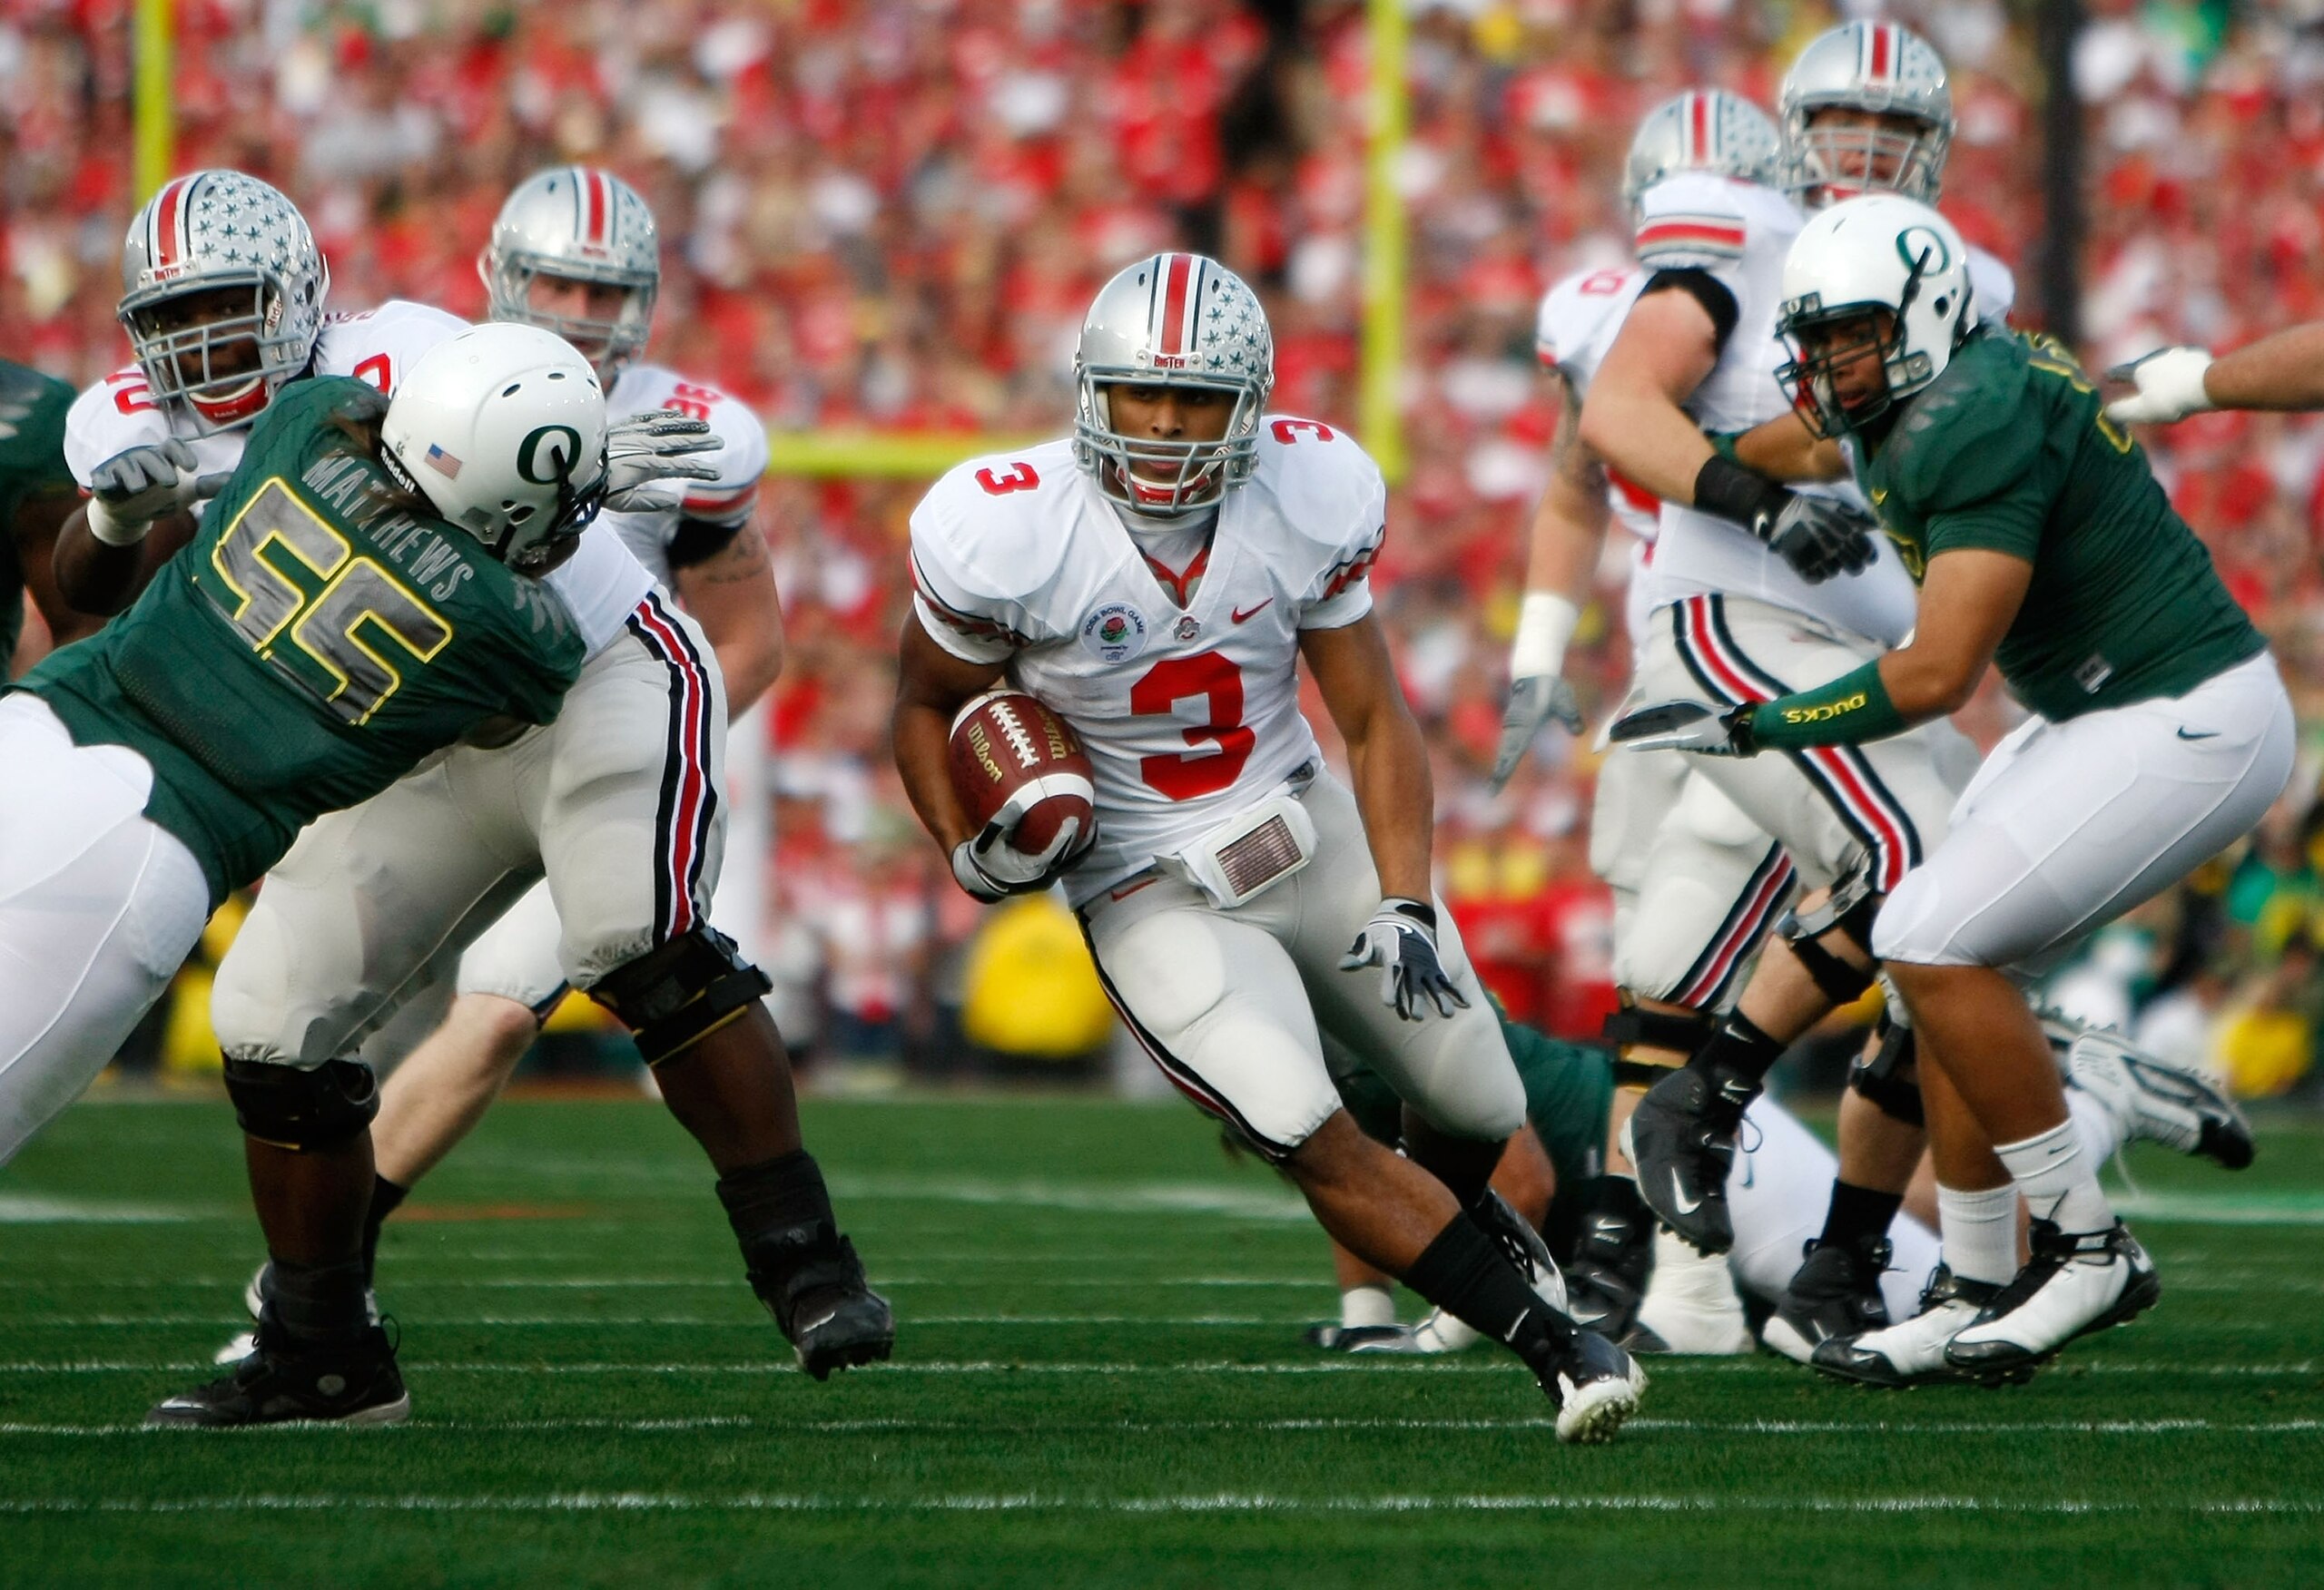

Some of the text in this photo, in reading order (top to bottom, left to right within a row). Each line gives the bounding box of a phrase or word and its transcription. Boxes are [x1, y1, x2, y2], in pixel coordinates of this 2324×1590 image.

[1269, 420, 1334, 446] 3
[380, 446, 416, 493] Riddell
[974, 462, 1040, 496] 3
[211, 476, 454, 726] 55
[1100, 606, 1127, 617] BOWL
[1130, 651, 1256, 802] 3
[1786, 694, 1866, 724] DUCKS
[967, 721, 1004, 785] Wilson
